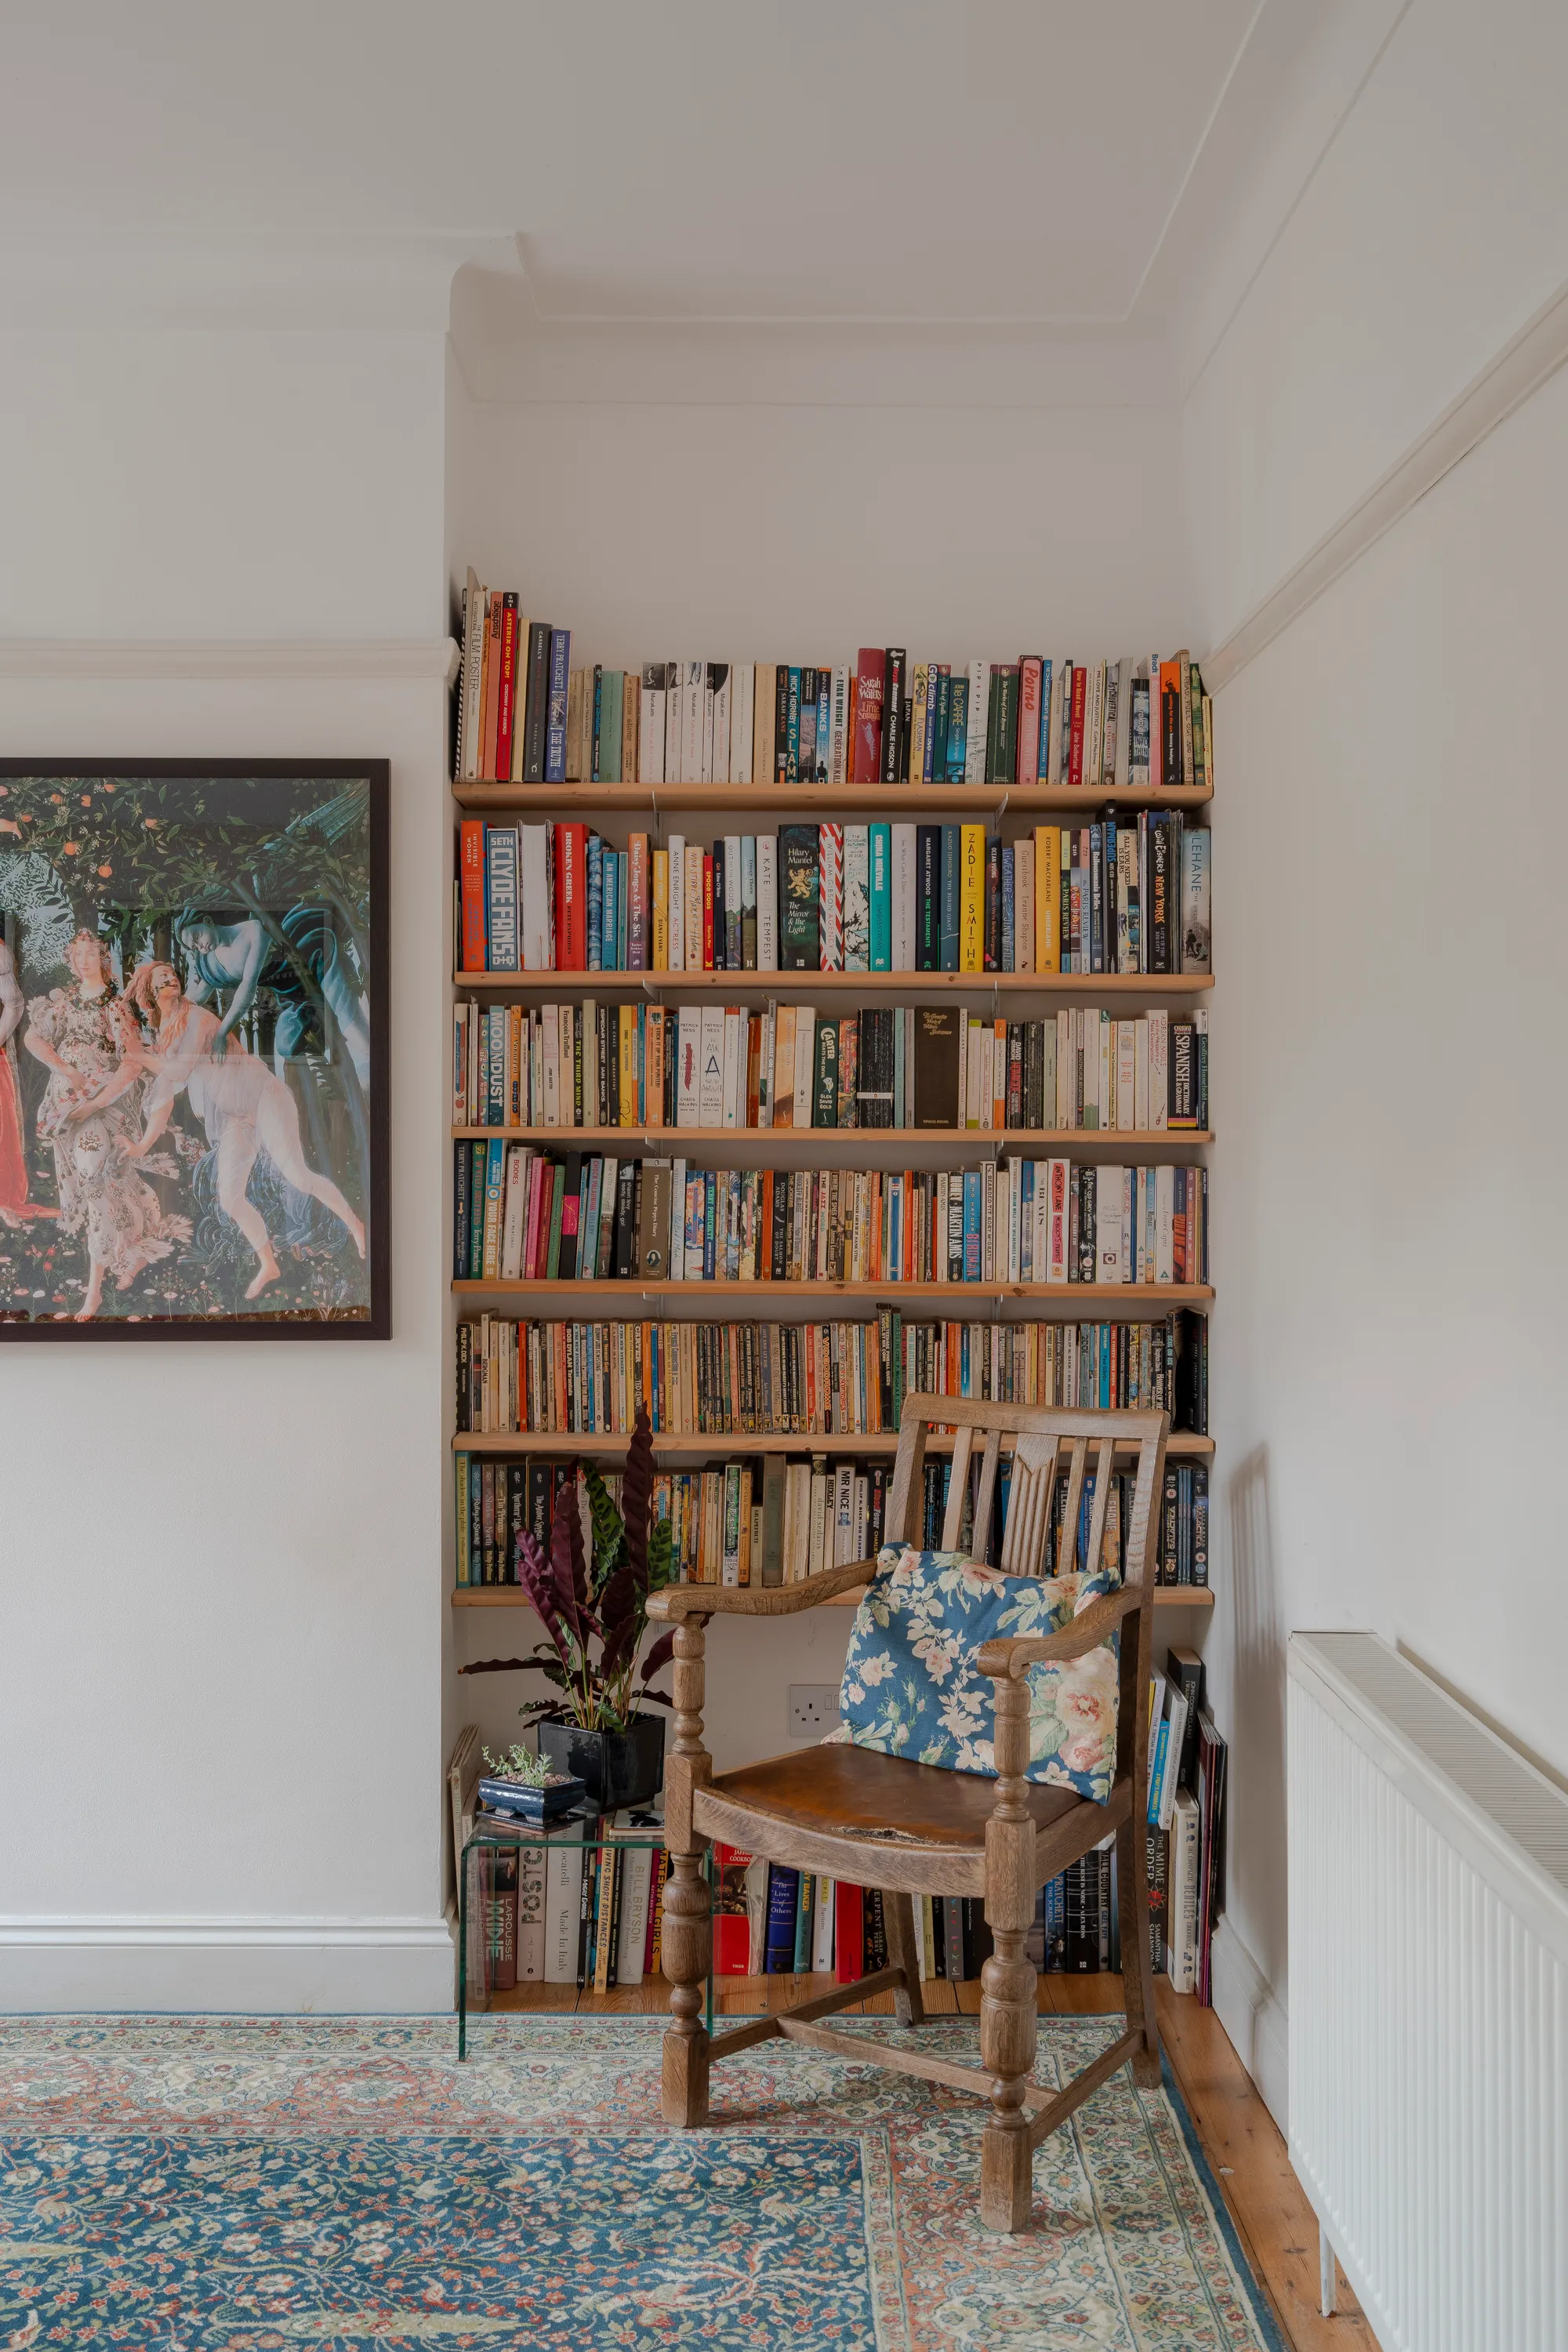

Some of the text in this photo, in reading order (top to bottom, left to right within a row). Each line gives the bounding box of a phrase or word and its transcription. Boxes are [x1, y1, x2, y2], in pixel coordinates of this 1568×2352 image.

[491, 601, 502, 639] Anschläge
[470, 633, 481, 653] FILM
[505, 646, 512, 657] ON
[554, 635, 565, 690] TERRY PRATCHETT
[469, 656, 480, 689] POSTER
[1024, 667, 1039, 711] Porno
[788, 676, 798, 725] NICK HORNBY
[818, 692, 828, 732] BANKS
[835, 680, 844, 728] EVAN WRIGHT
[550, 732, 562, 768] THE TRUTH
[786, 729, 797, 778] SLAM
[833, 731, 842, 769] GENERATION
[1023, 716, 1036, 774] IRVINE WELSH
[605, 863, 613, 872] AN
[632, 840, 642, 867] Daisy
[875, 858, 884, 891] MIÉVILLE
[1191, 837, 1202, 892] LEHANE
[491, 848, 514, 955] CLYDE FANS
[631, 868, 641, 892] Jones
[966, 833, 977, 959] ZADIE SMITH
[631, 923, 641, 938] Six
[633, 905, 641, 921] The
[789, 926, 806, 935] Light
[490, 1011, 503, 1107] MOONDUST
[821, 1027, 836, 1058] CARTER
[1175, 1035, 1191, 1083] SPANISH
[1054, 1165, 1062, 1210] ANTHONY LANE
[471, 1228, 482, 1272] Terry Pratchett
[486, 1201, 498, 1265] YOUR FACE HERE
[949, 1206, 962, 1259] MARTIN AMIS
[965, 1233, 980, 1277] BIRDMAN
[822, 1337, 832, 1410] VIDEODROME
[840, 1470, 851, 1509] MR NICE
[1100, 1872, 1109, 1908] COUNTRY
[1155, 1852, 1165, 1884] MIME
[599, 1875, 612, 1948] SHORT DISTANCES
[630, 1865, 645, 1944] BILL BRYSON
[802, 1883, 811, 1911] BAKER
[1054, 1875, 1064, 1924] PRATCHETT
[555, 1909, 570, 1973] Made In Italy
[651, 1916, 662, 1954] GIRLS
